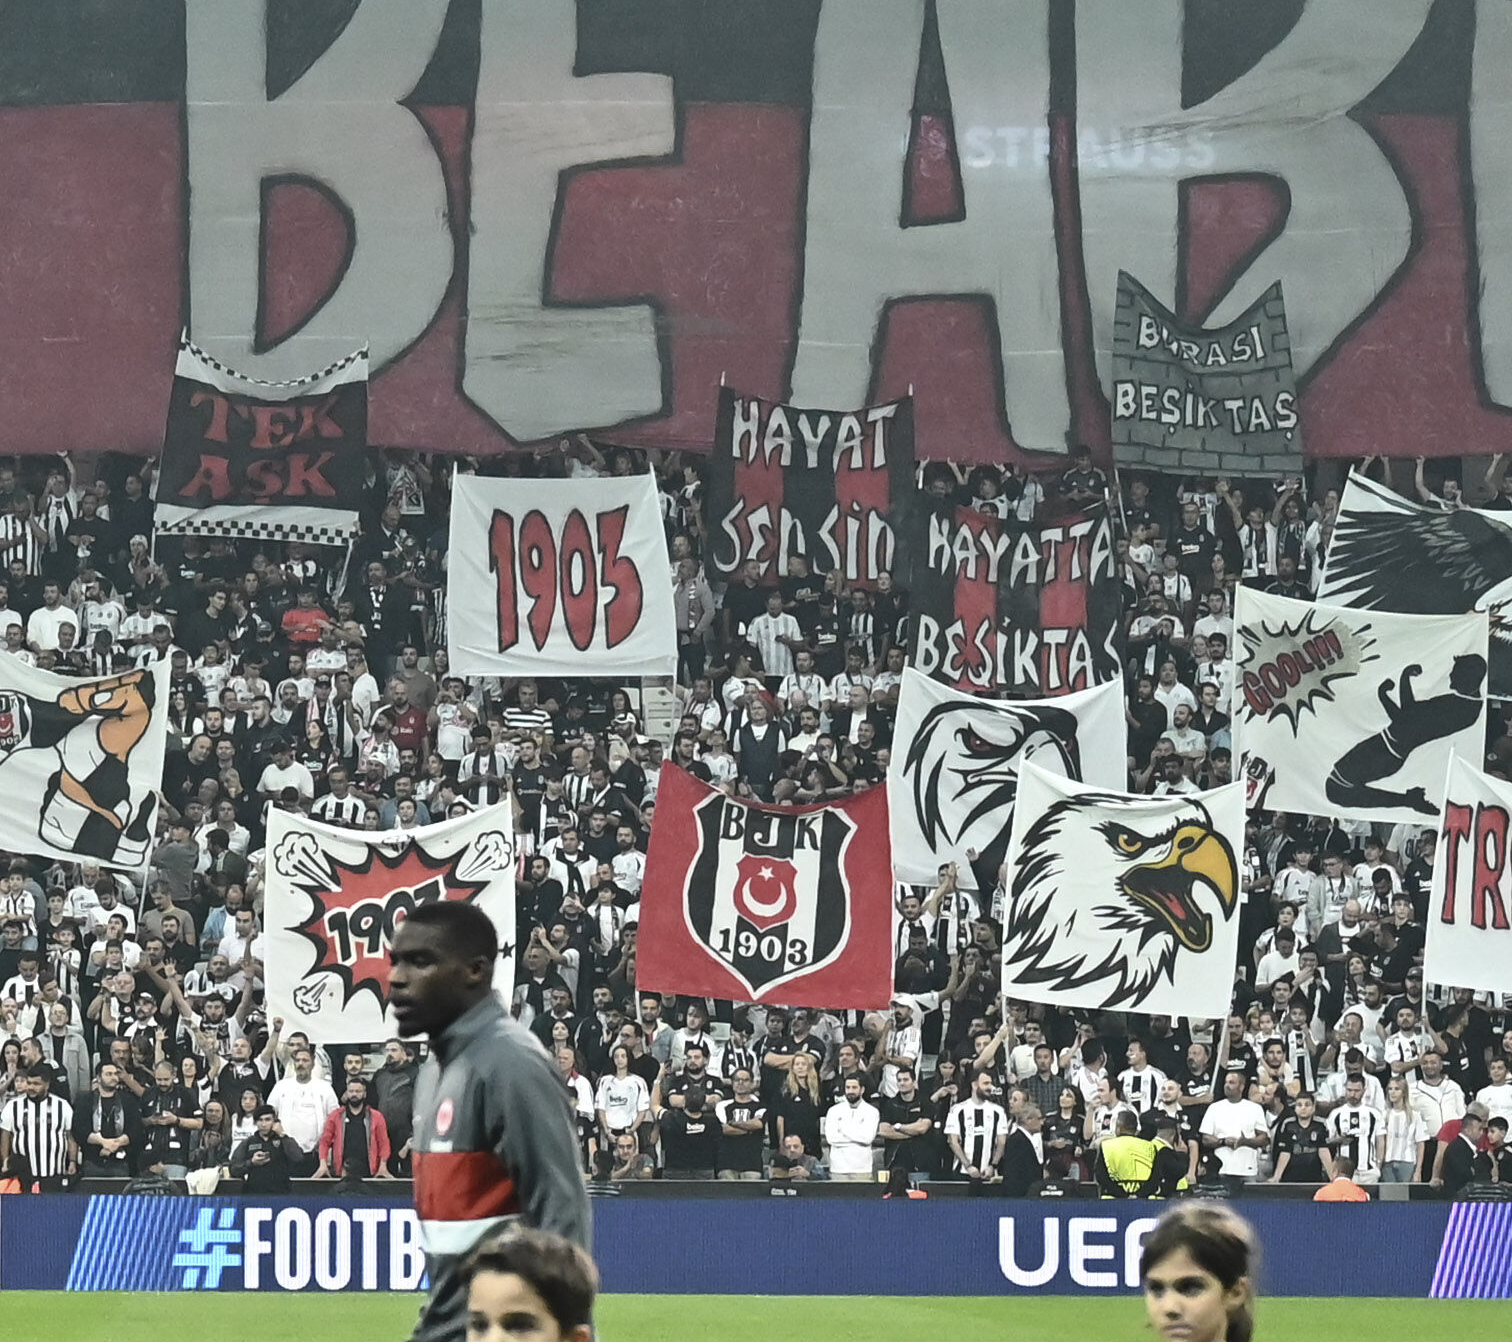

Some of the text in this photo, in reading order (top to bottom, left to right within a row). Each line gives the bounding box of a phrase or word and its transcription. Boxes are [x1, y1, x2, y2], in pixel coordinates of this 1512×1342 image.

[1138, 314, 1266, 367] BURASI
[189, 393, 344, 449] TEK
[732, 398, 897, 469] HAYAT
[1114, 380, 1299, 441] BEŞİKTAŞ
[178, 451, 337, 504] AŞK
[720, 802, 821, 852] BJK
[718, 926, 808, 968] 1903
[997, 1216, 1159, 1287] UEF
